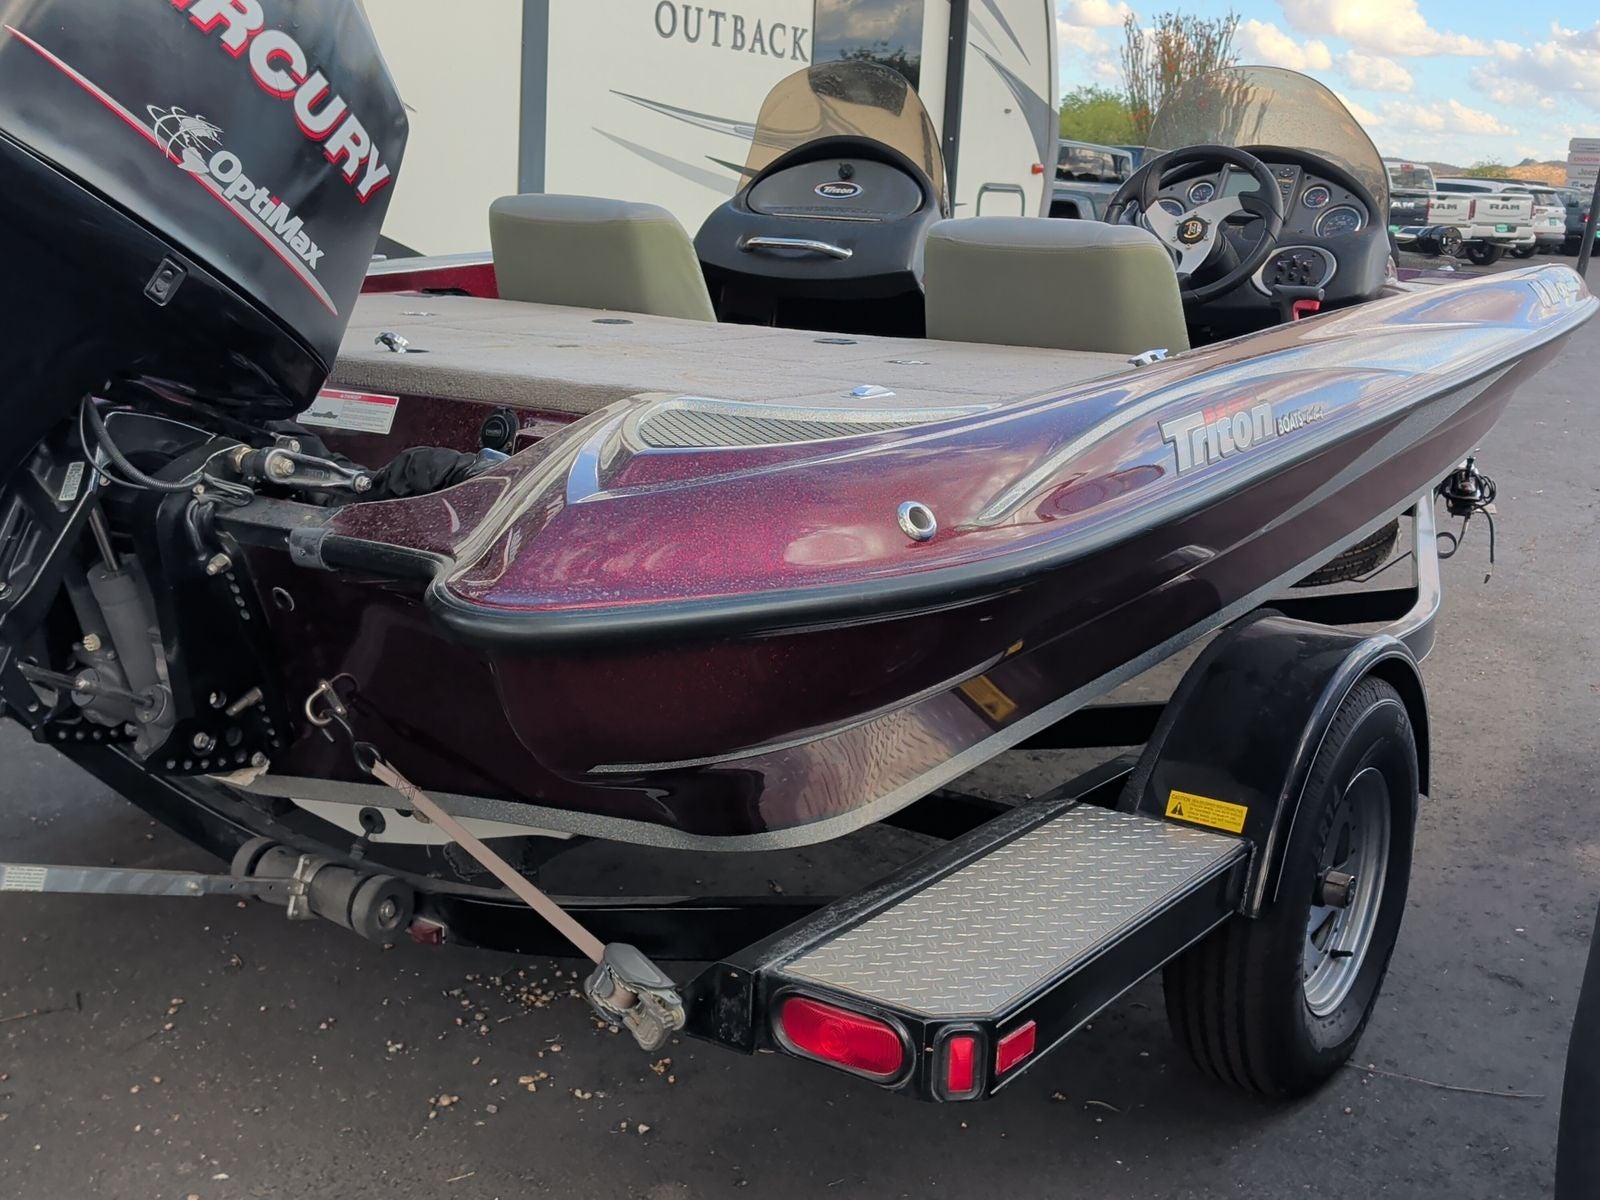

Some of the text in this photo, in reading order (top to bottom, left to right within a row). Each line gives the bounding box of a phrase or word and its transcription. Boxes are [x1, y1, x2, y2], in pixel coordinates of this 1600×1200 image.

[654, 0, 809, 63] OUTBACK
[170, 0, 391, 205] RCURY
[208, 150, 325, 270] OptiMax
[1489, 203, 1520, 211] RAM
[1158, 402, 1275, 475] Triton
[1276, 410, 1304, 436] BOATS
